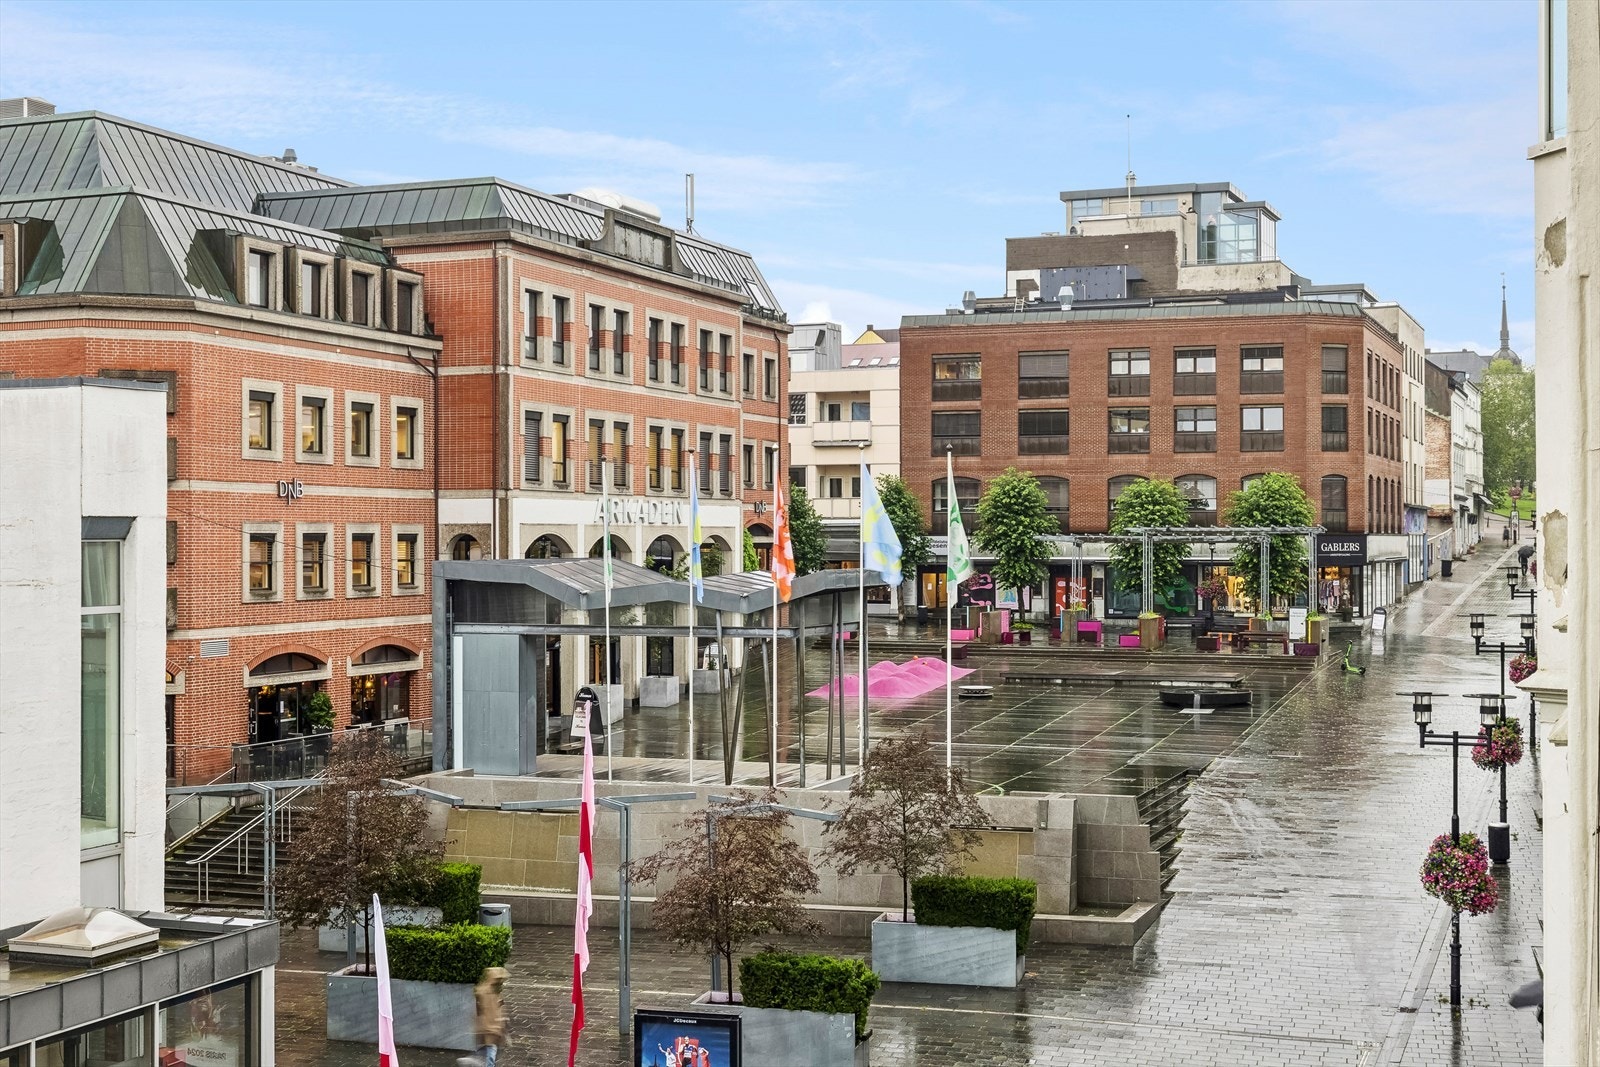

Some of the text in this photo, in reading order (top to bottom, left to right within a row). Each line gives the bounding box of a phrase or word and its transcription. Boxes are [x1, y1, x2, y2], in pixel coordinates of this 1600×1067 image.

[278, 478, 304, 505] DNB
[594, 499, 682, 525] ARKADEN
[754, 500, 767, 517] DNB
[1320, 542, 1360, 552] GABLERS
